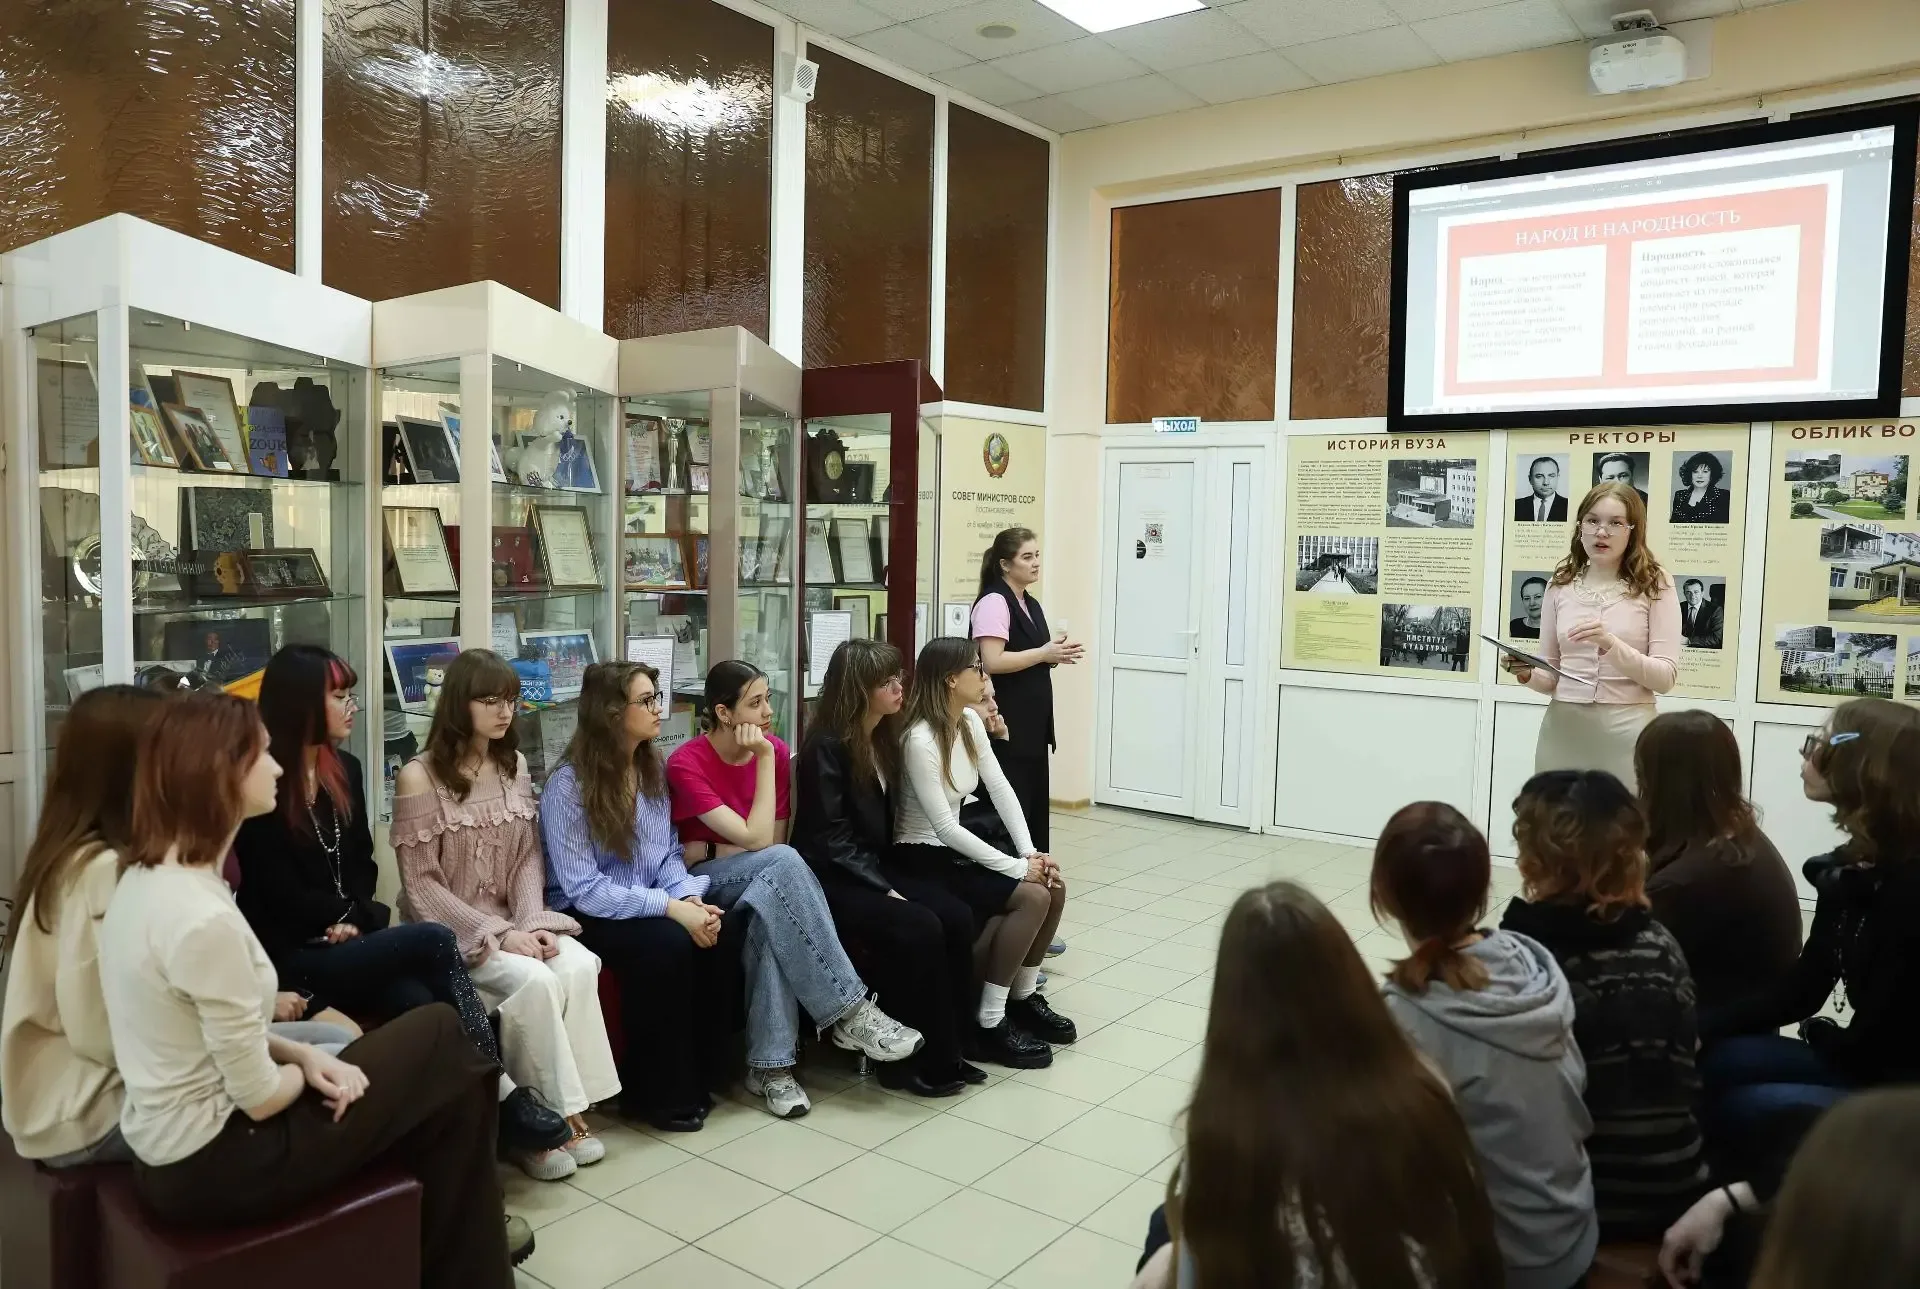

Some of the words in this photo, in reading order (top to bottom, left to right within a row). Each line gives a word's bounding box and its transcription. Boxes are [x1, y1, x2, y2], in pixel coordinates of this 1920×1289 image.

[1515, 226, 1578, 246] НАРОД
[1584, 224, 1597, 239] И
[1603, 209, 1741, 237] НАРОДНОСТЬ
[1569, 431, 1676, 445] РЕКТОРЫ
[1791, 425, 1873, 440] ОБЛИК
[1881, 424, 1916, 438] ВО
[1327, 439, 1400, 450] ИСТОРИЯ
[1405, 438, 1446, 449] ВУЗА
[952, 491, 976, 501] СОВЕТ
[977, 492, 1018, 504] МИНИСТРОВ
[1018, 495, 1036, 504] СССР
[1406, 634, 1446, 643] ИНСТИТУТ
[1402, 642, 1448, 653] КУЛЬТУРЫ
